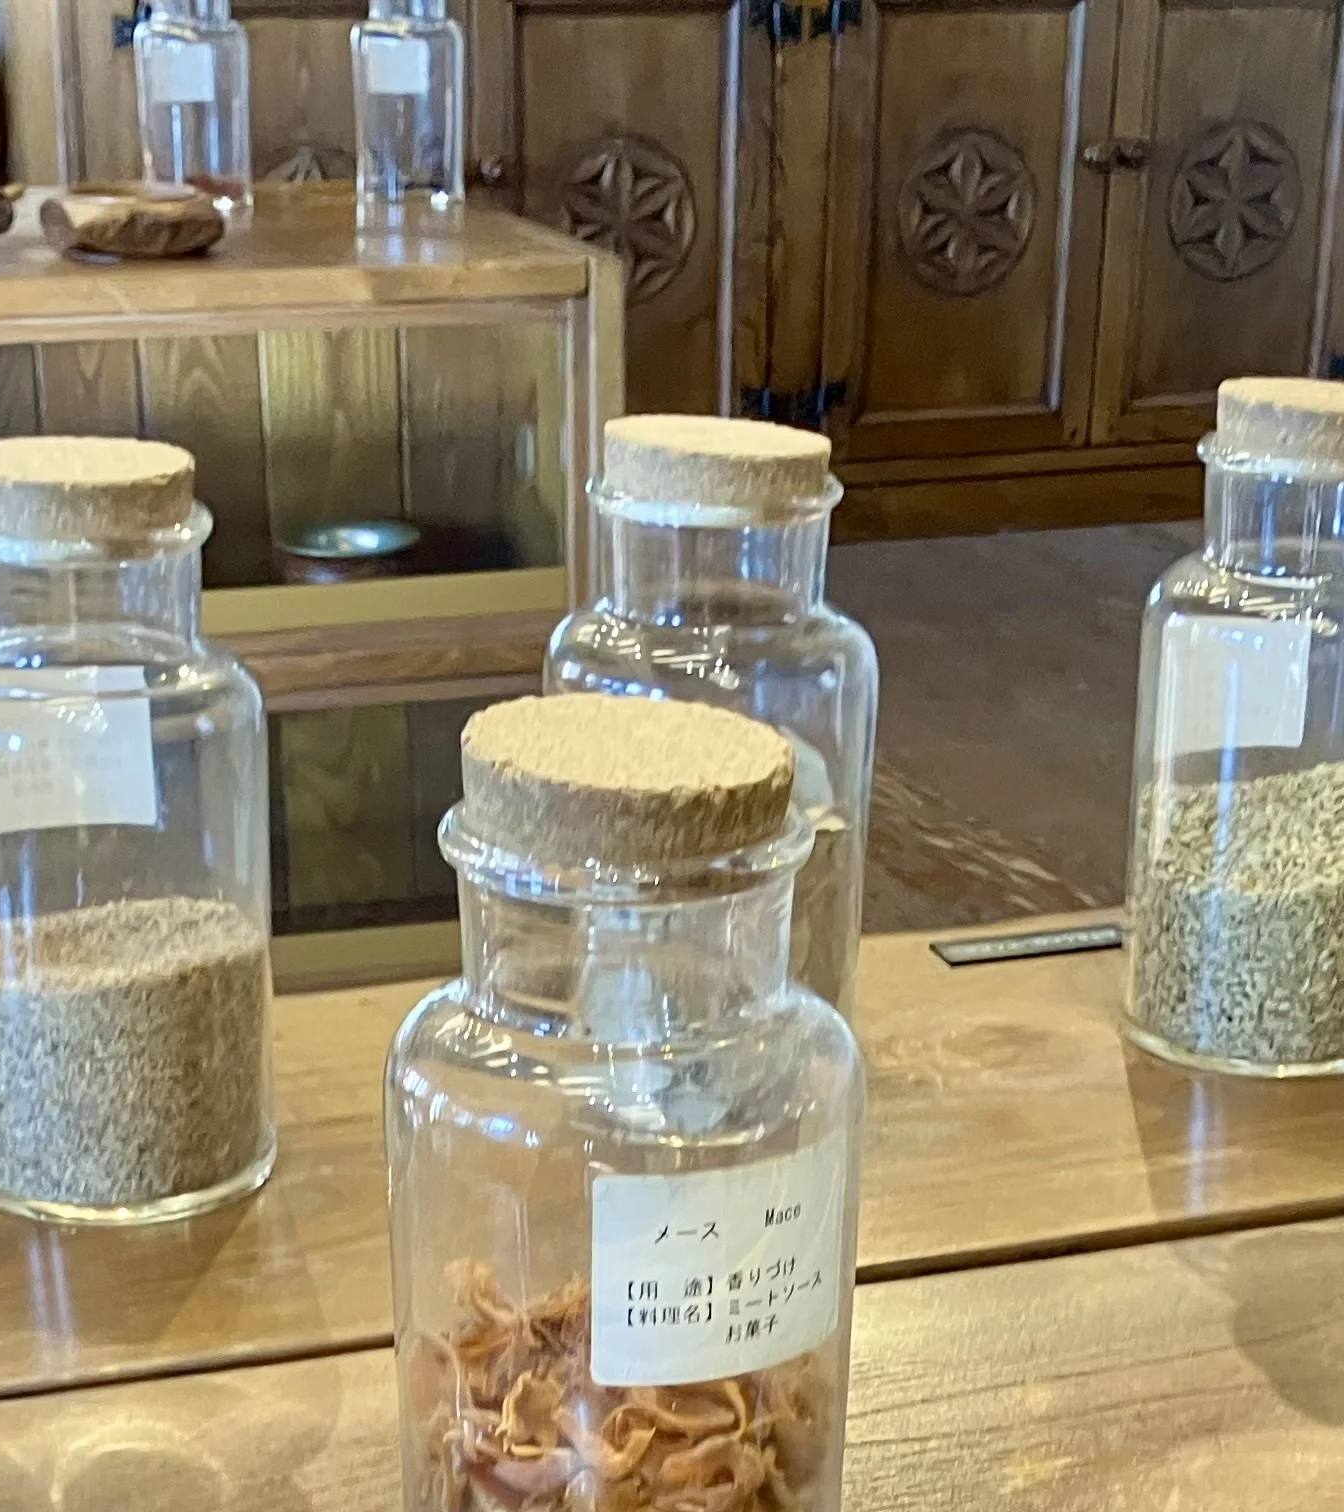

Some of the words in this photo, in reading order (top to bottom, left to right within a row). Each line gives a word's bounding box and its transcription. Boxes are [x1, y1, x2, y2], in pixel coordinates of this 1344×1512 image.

[654, 1222, 719, 1244] メース
[765, 1201, 801, 1228] Mace
[725, 1313, 779, 1344] お菓子
